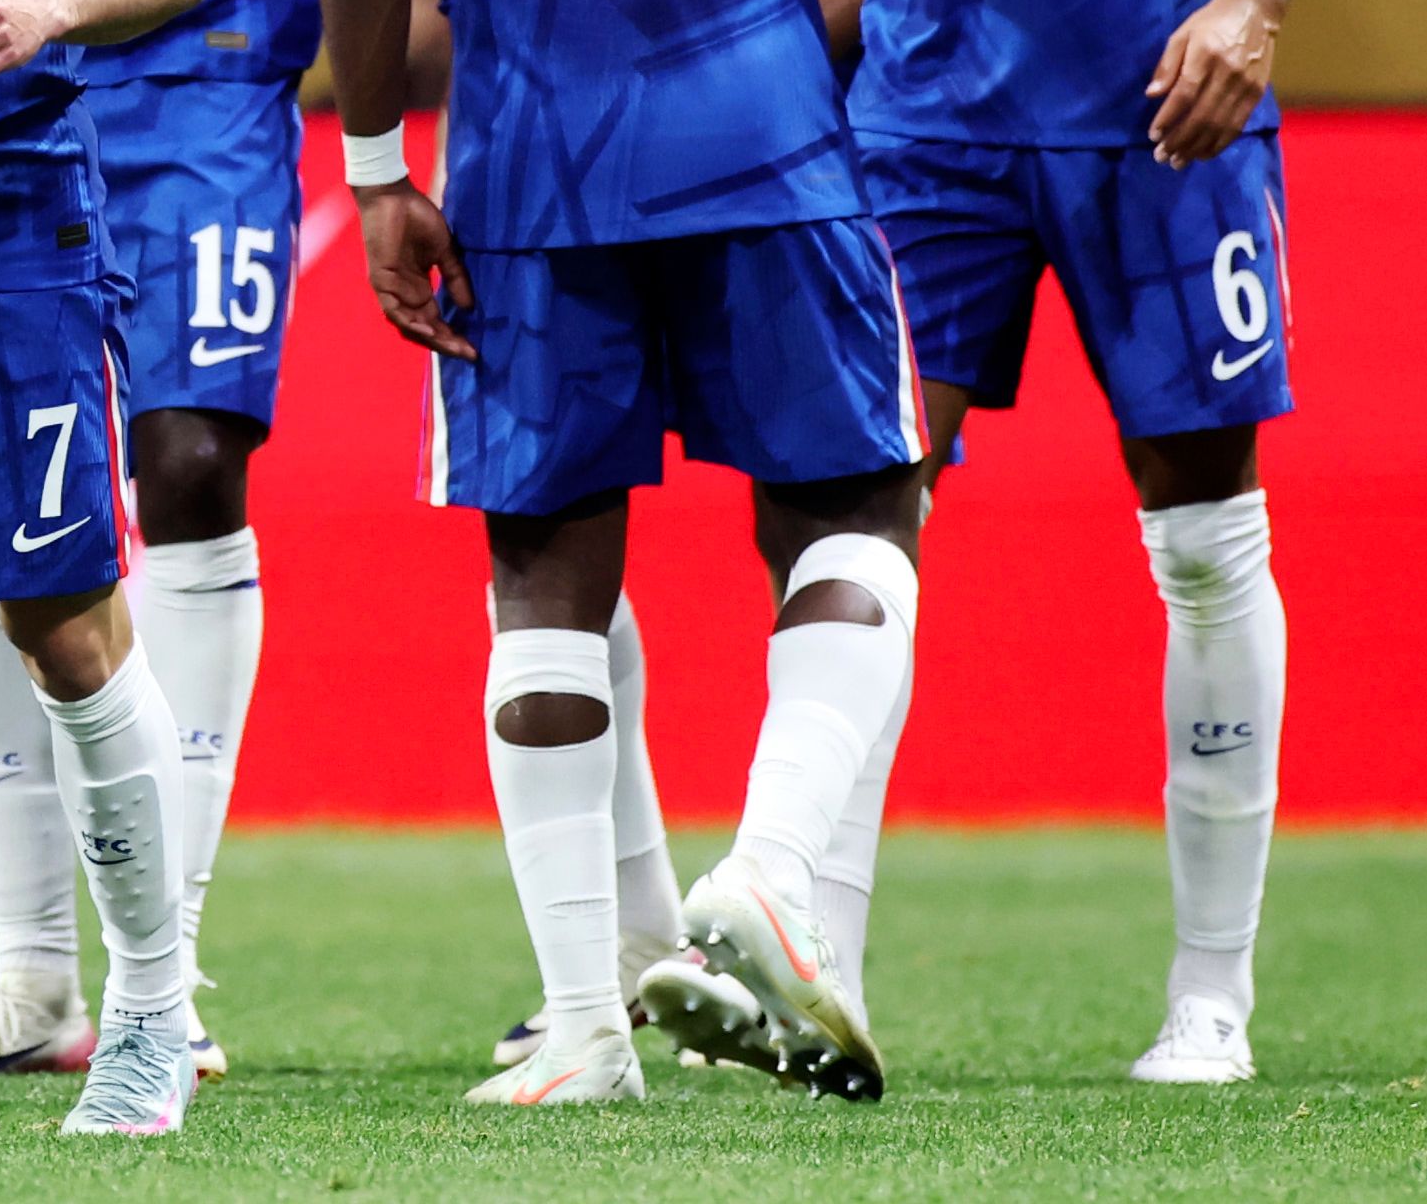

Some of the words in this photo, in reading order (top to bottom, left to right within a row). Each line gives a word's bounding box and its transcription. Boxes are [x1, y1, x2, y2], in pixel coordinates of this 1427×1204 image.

[188, 223, 275, 335] 15
[1213, 231, 1267, 342] 6
[27, 403, 78, 519] 7
[1192, 721, 1253, 738] CFC
[81, 831, 133, 855] CFC
